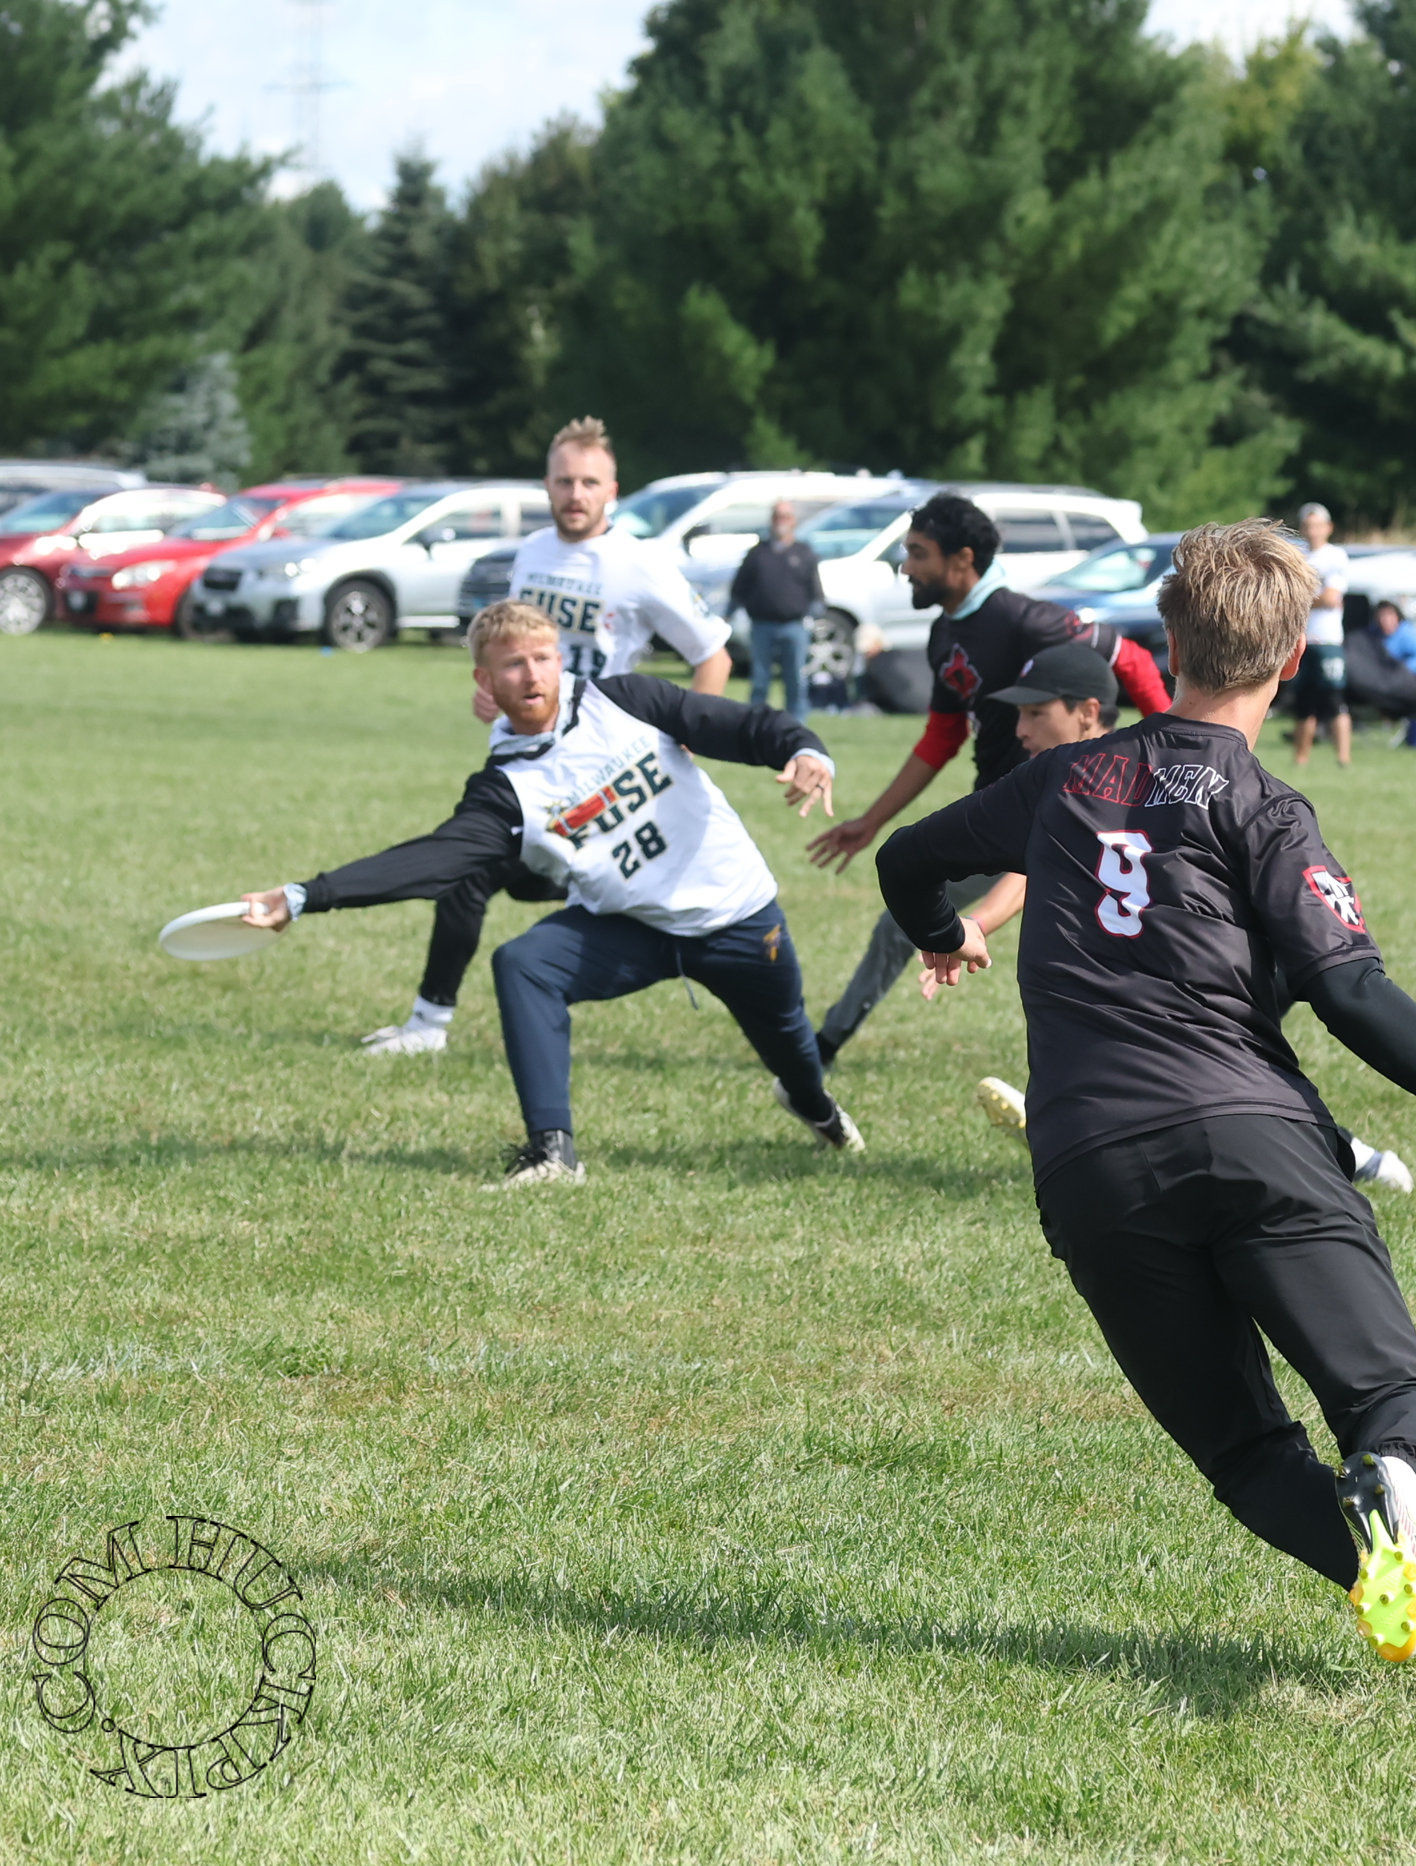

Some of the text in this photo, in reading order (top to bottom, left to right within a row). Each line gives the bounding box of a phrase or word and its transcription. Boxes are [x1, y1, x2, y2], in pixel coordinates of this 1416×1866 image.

[566, 735, 651, 806] MILWAUKEE
[611, 821, 668, 880] 28
[1095, 829, 1153, 939] 9
